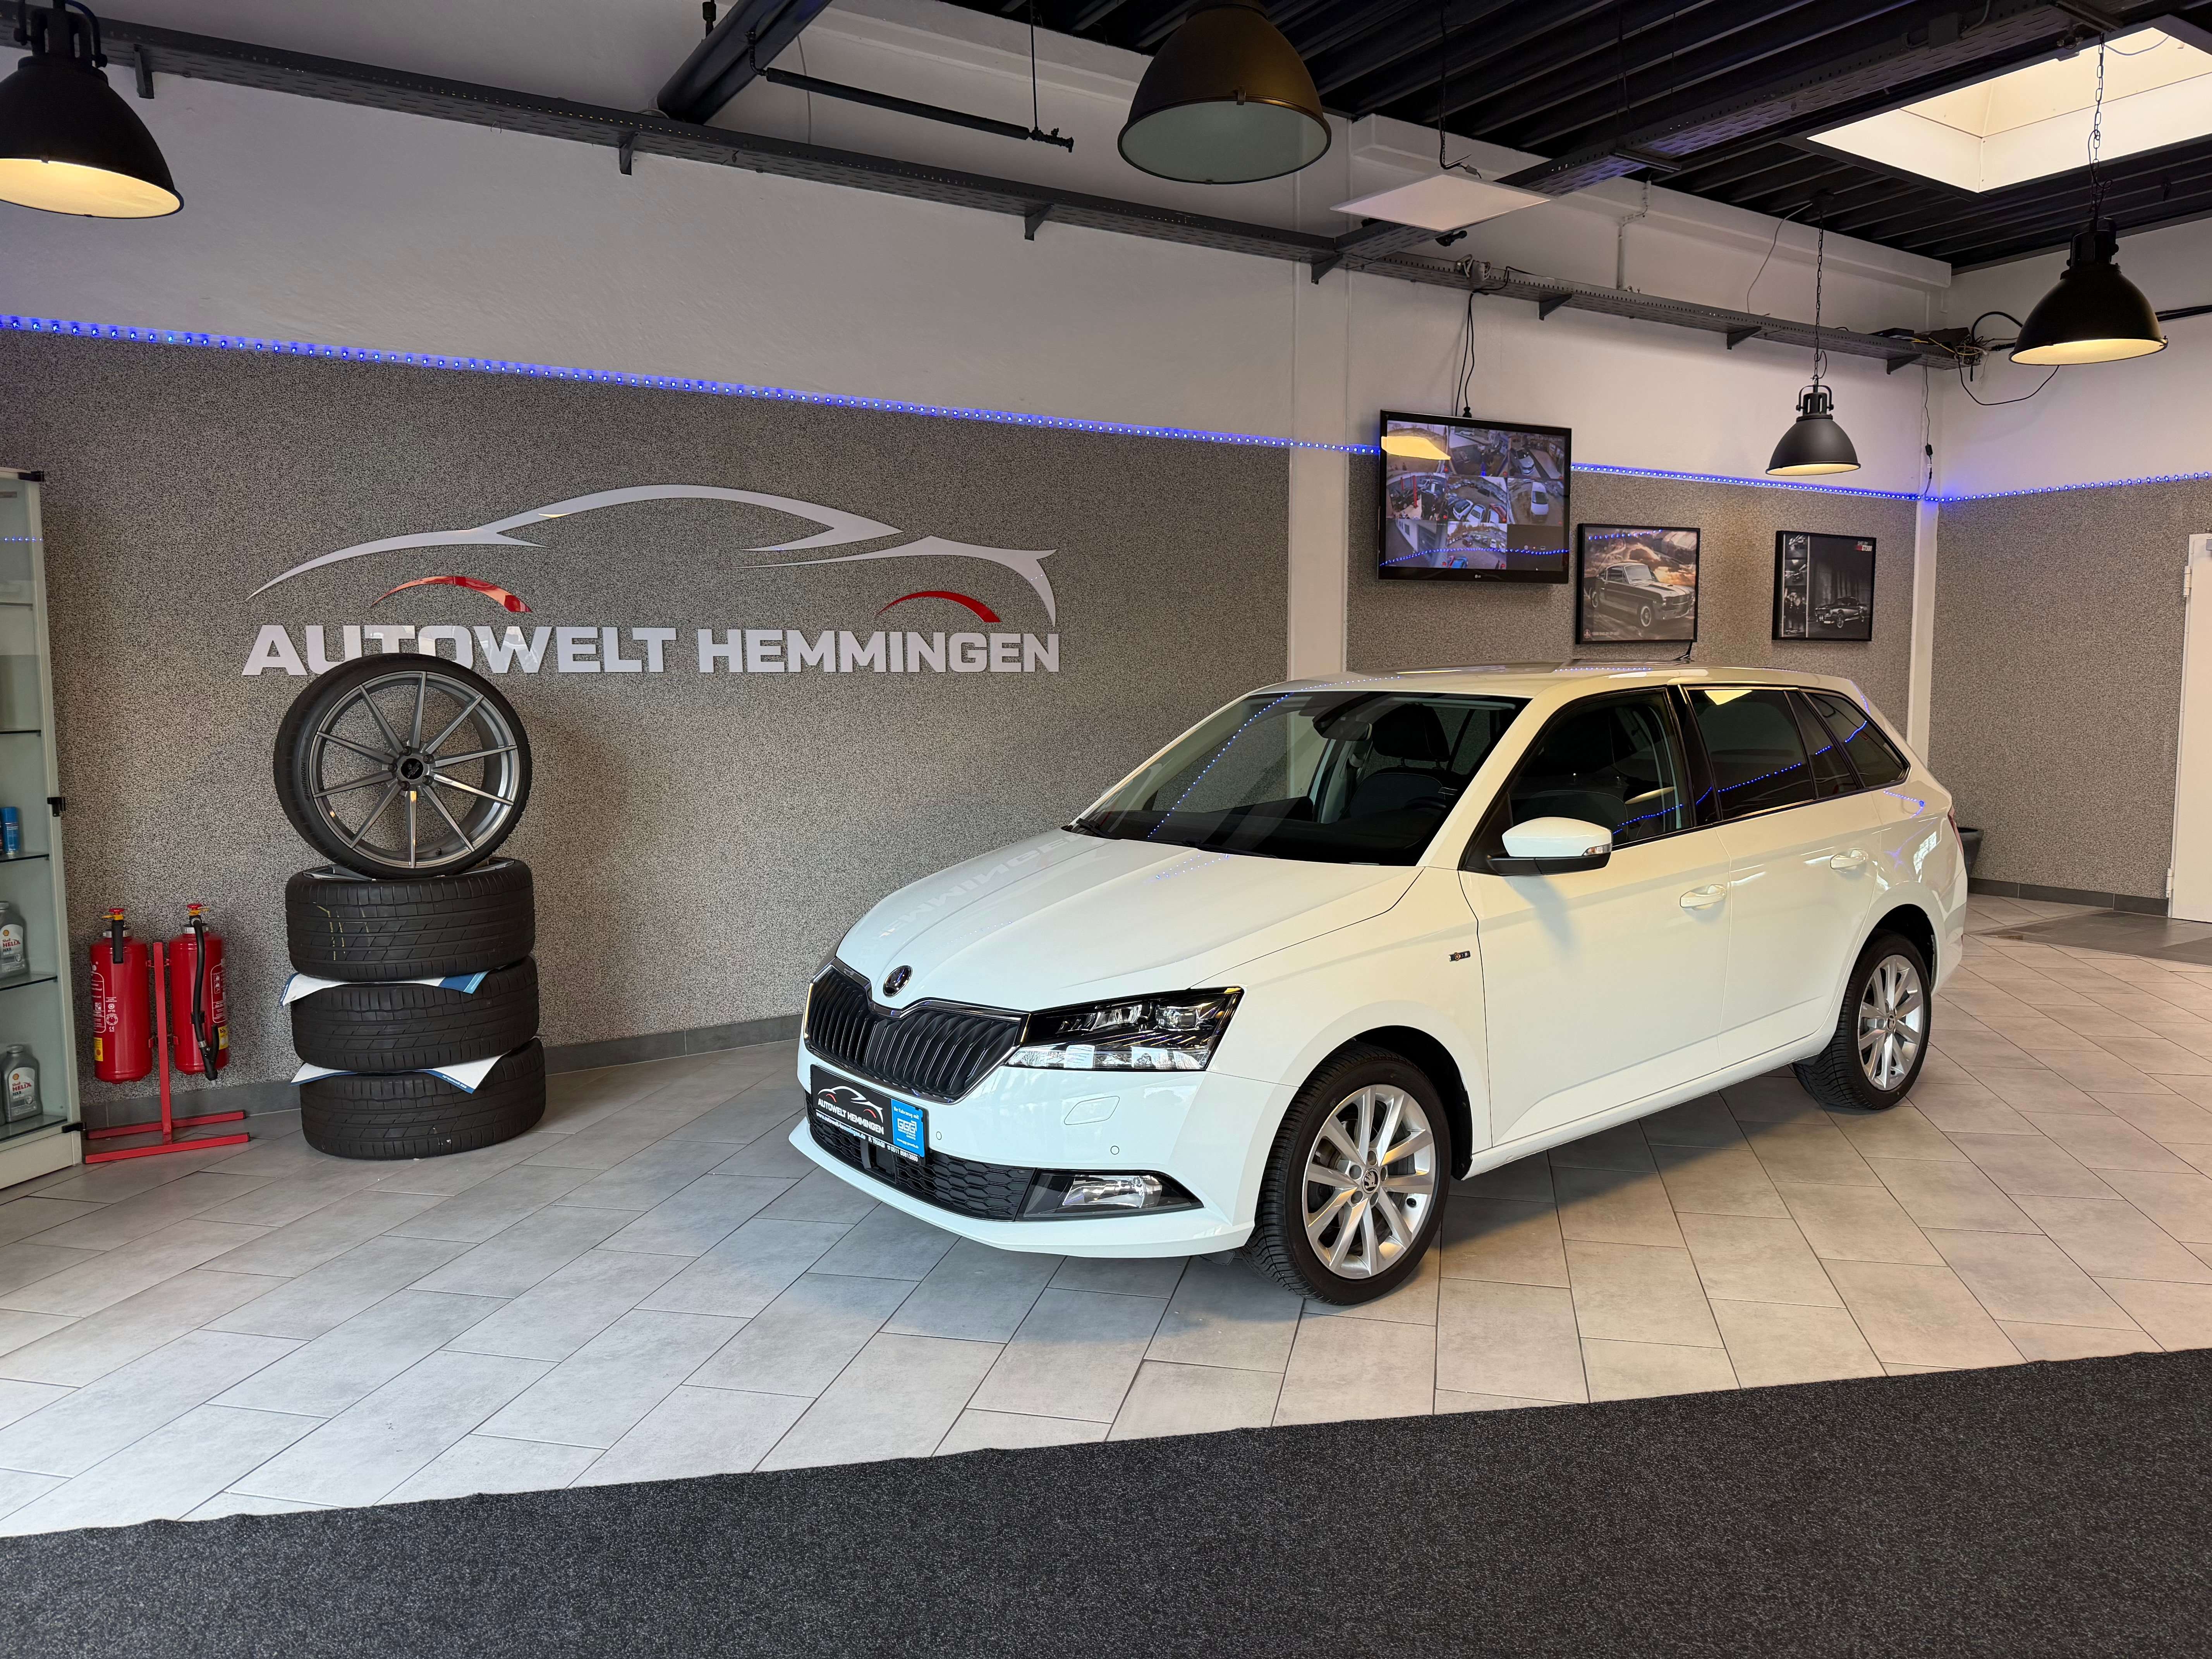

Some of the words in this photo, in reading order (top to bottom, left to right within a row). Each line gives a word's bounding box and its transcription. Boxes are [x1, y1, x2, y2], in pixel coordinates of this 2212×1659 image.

[242, 625, 677, 675] AUTOWELT
[698, 629, 1059, 673] HEMMINGEN
[3, 939, 21, 948] HELIX
[12, 1082, 32, 1091] HELIX
[818, 1098, 847, 1118] AUTOWELT
[847, 1112, 884, 1135] HEMMINGEN
[897, 1118, 917, 1135] GGG
